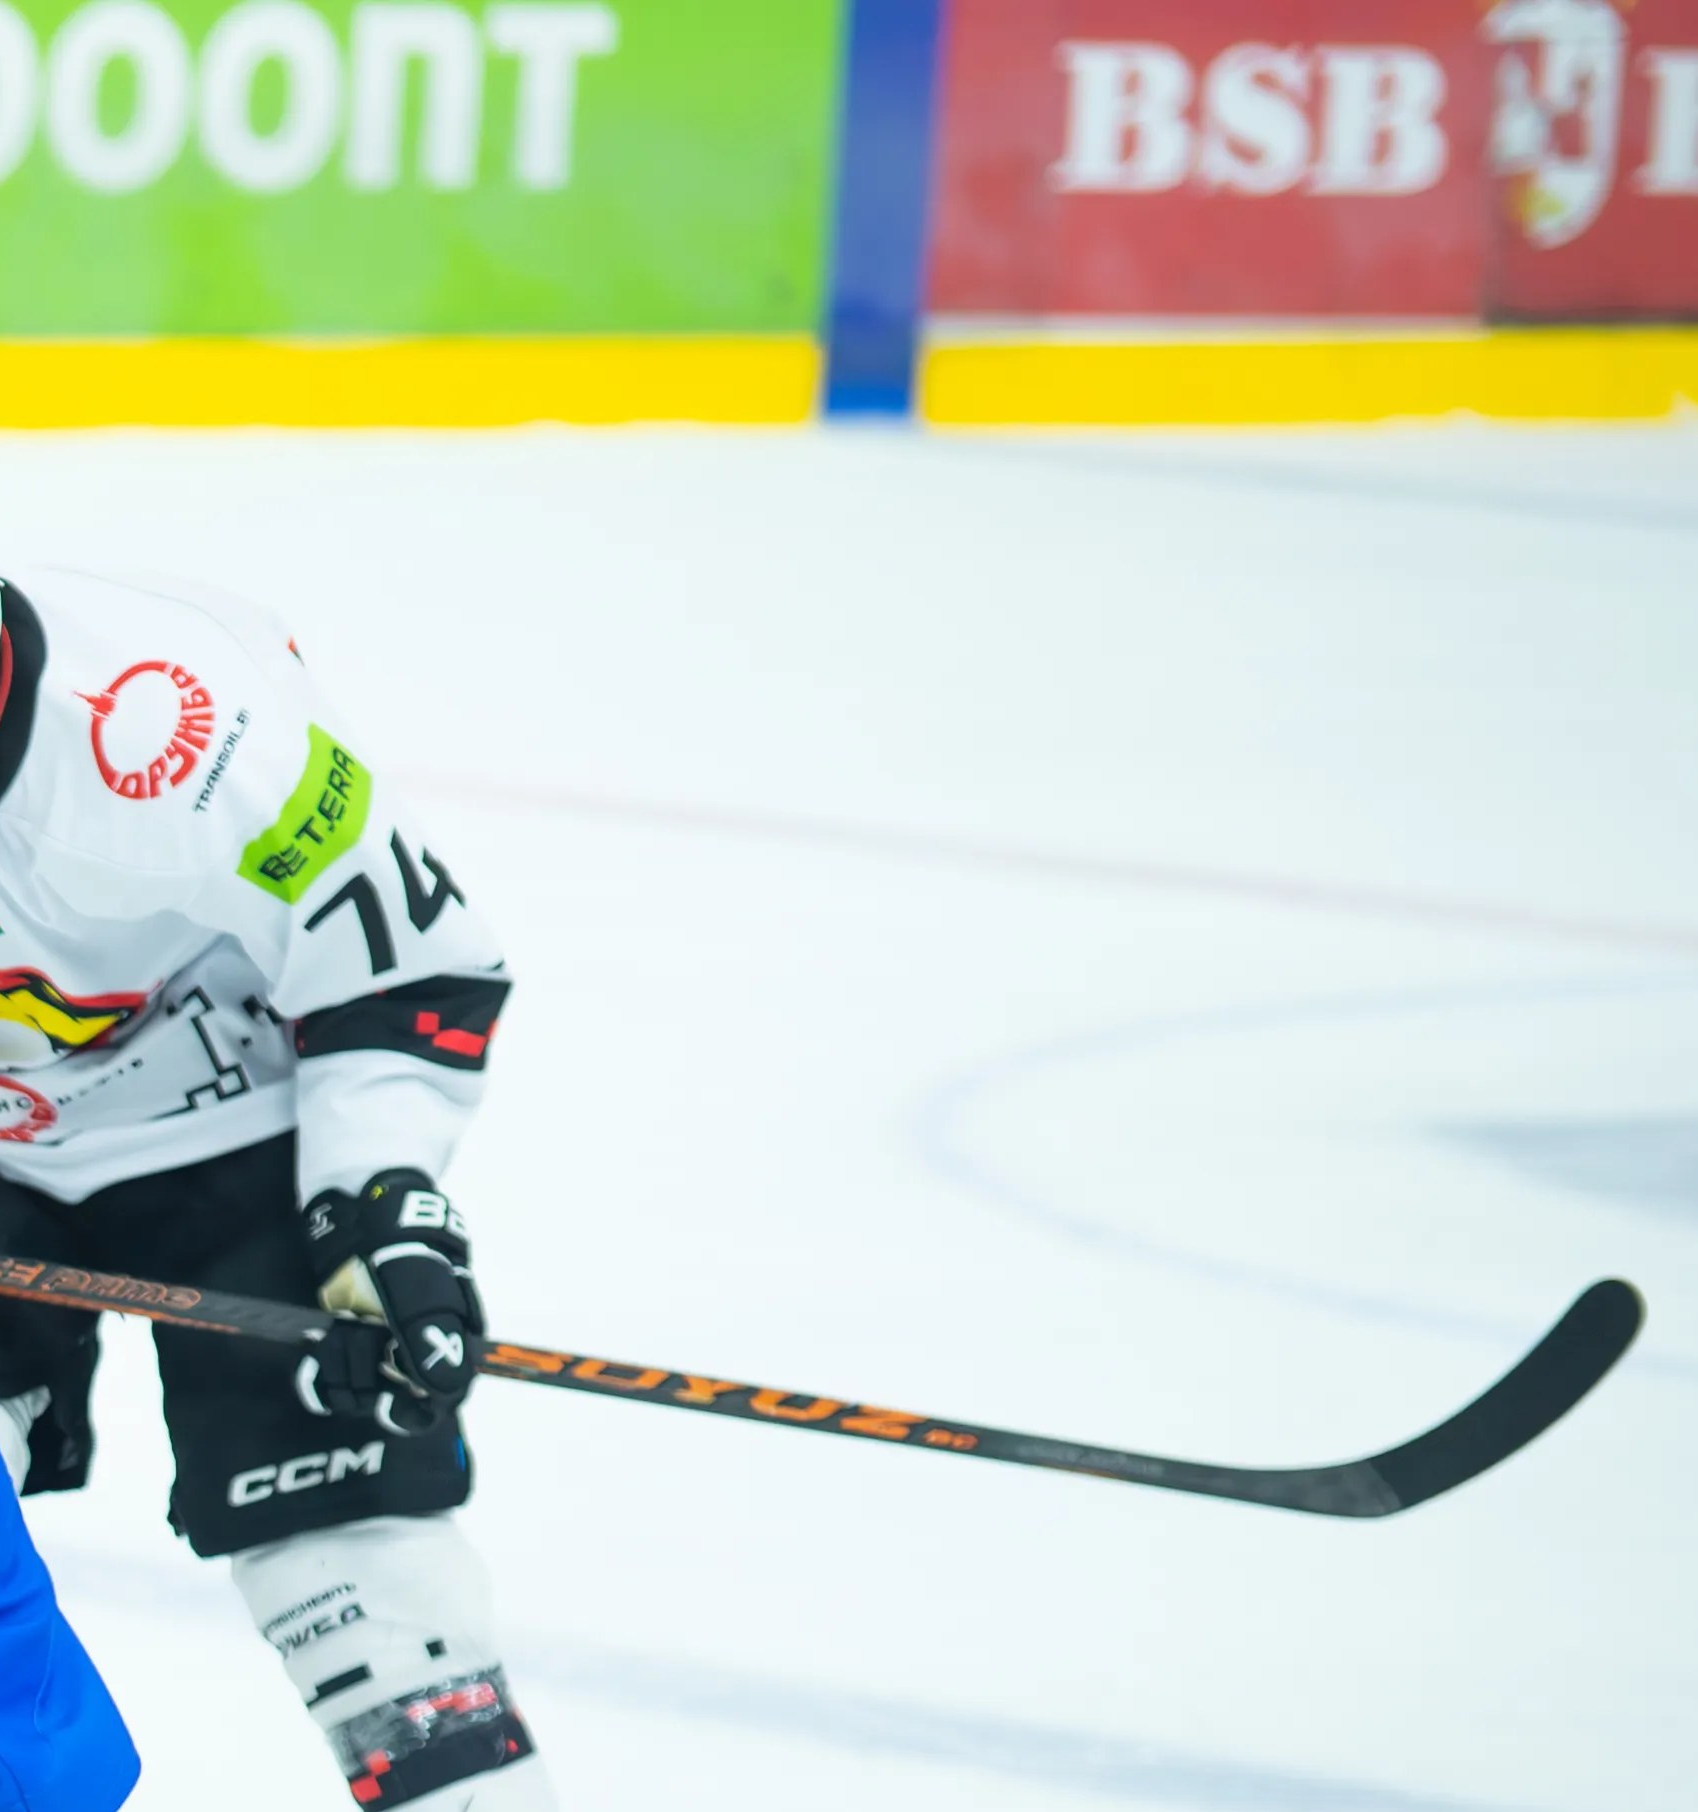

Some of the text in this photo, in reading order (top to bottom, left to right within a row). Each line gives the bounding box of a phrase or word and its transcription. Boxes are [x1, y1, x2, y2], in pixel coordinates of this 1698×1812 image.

[1045, 40, 1448, 194] BSB
[303, 825, 467, 977] 74
[485, 1345, 929, 1440] SOYUZ
[228, 1441, 385, 1508] CCM
